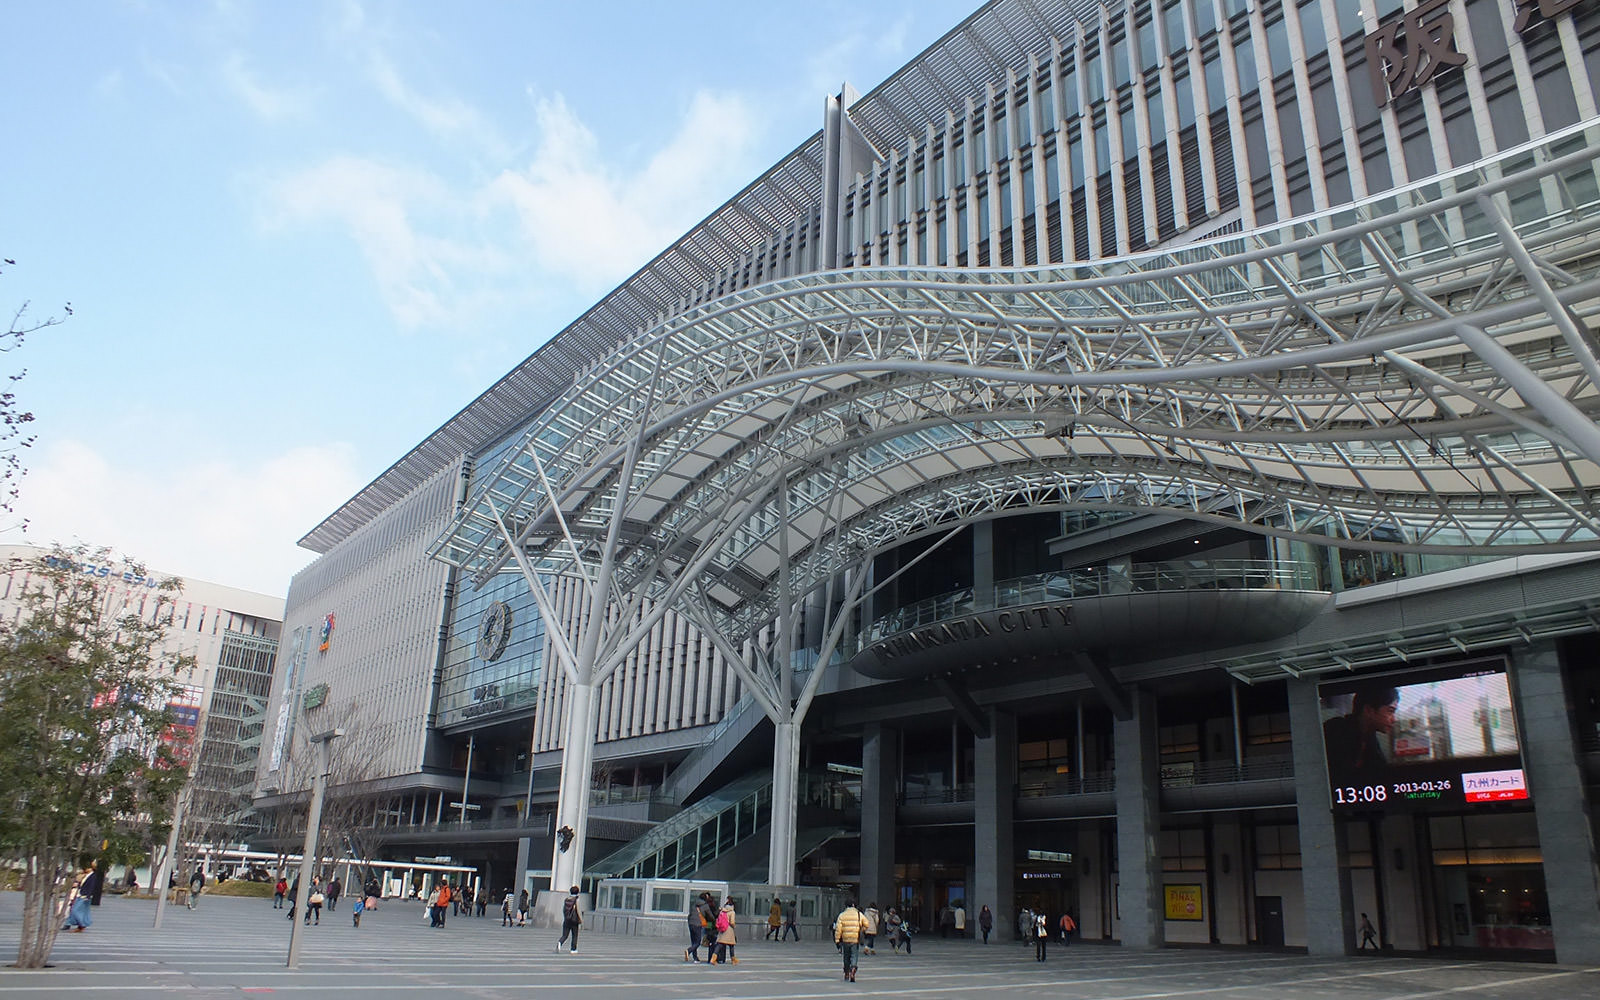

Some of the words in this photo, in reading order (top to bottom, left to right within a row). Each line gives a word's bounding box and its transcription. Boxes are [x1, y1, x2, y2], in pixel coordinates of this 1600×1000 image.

[891, 616, 990, 655] HAKATA
[998, 605, 1073, 632] CITY
[1393, 780, 1451, 793] 2013-01-26
[1466, 776, 1520, 789] 九州カード
[1335, 784, 1387, 804] 13:08
[1170, 893, 1195, 902] FINAL
